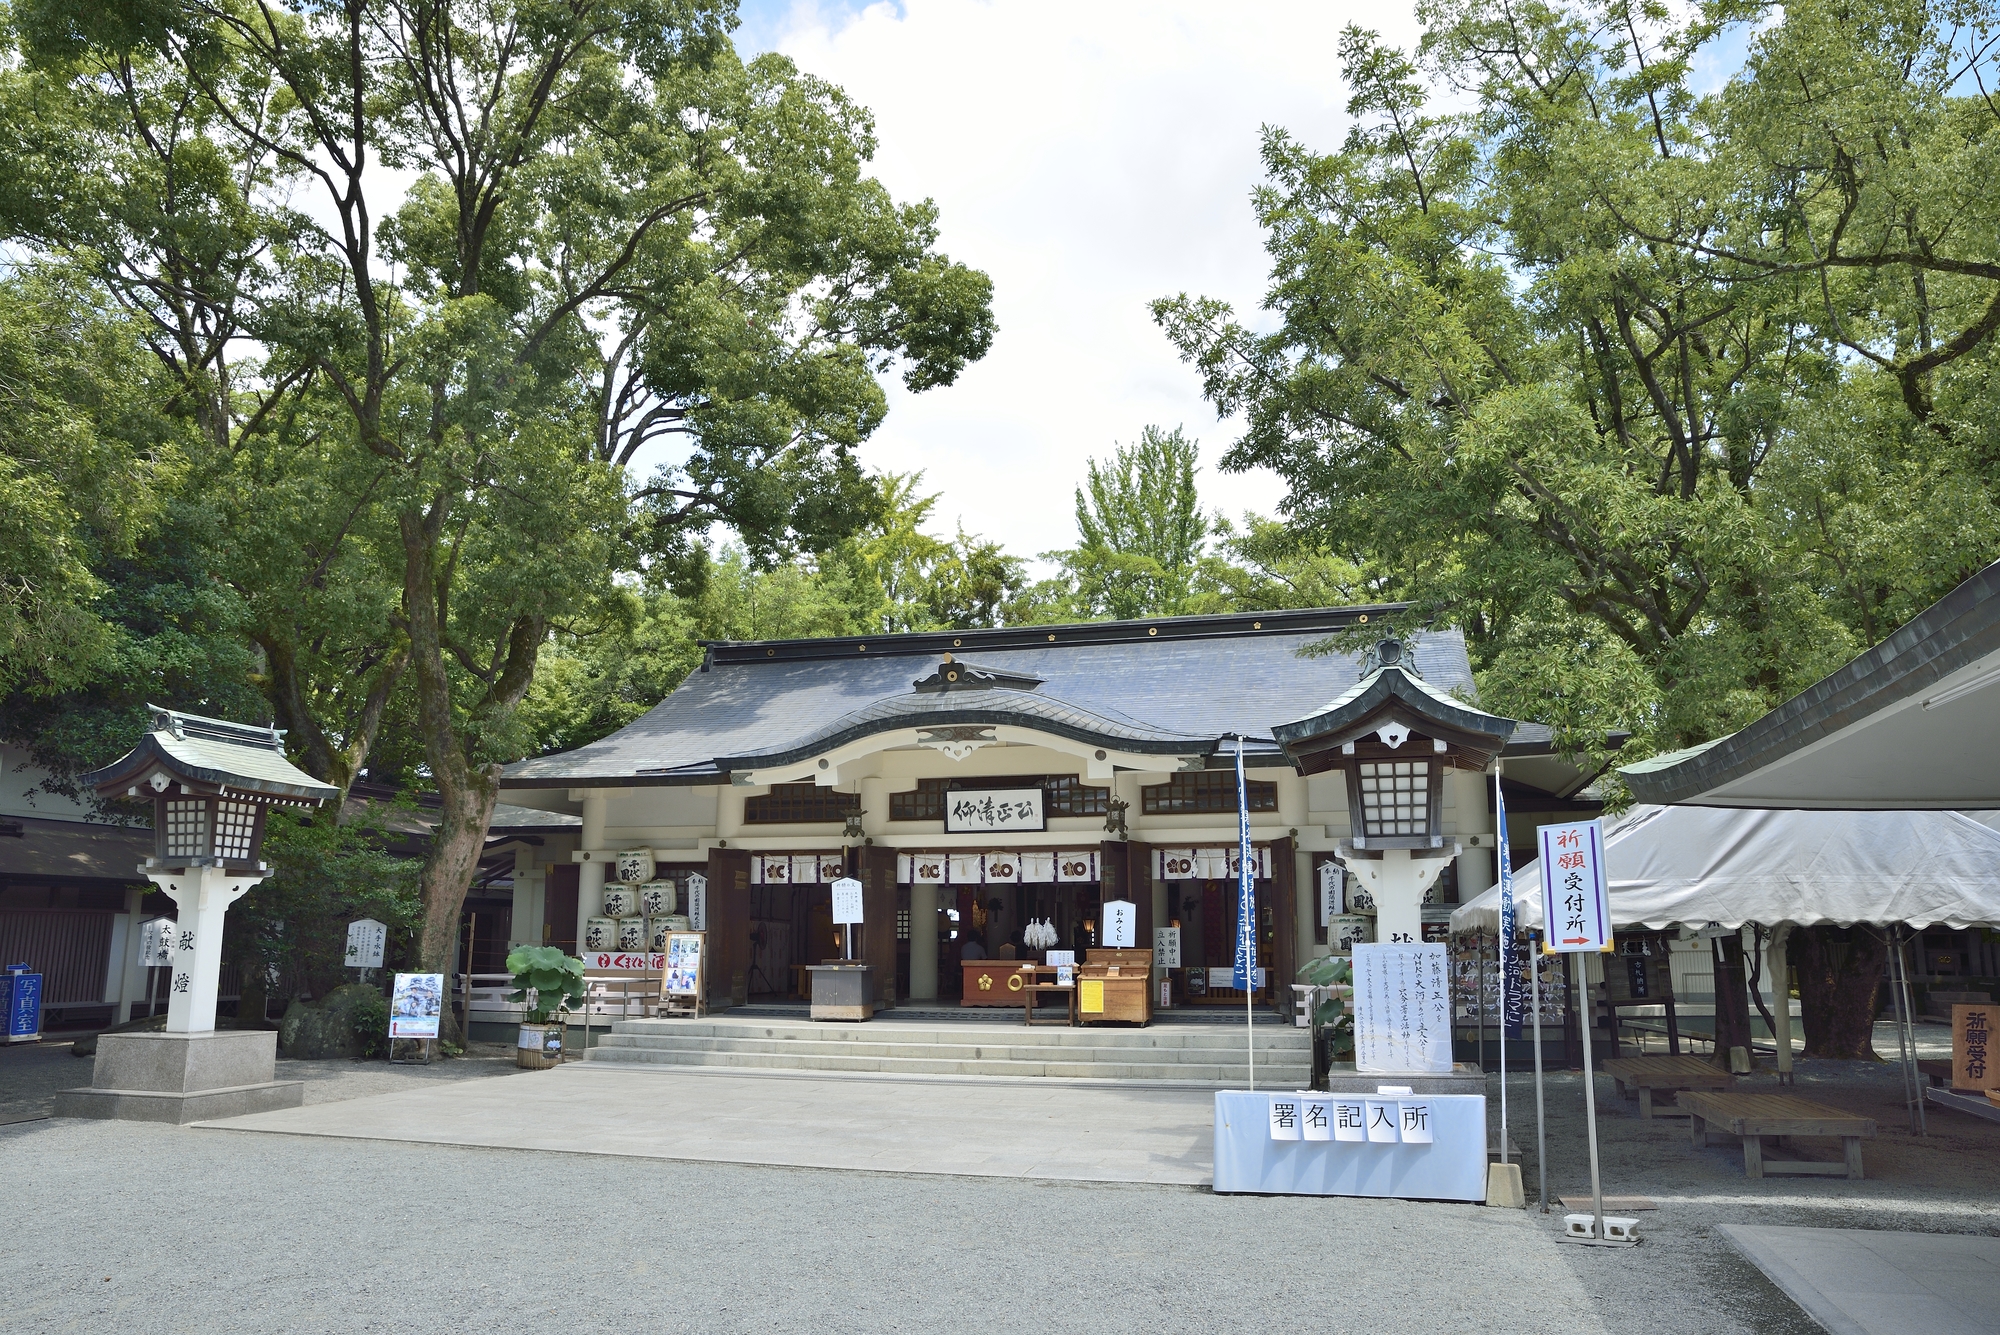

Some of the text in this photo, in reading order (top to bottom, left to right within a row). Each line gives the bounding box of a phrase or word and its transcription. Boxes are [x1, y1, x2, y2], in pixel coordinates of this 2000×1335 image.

[1556, 829, 1586, 934] 祈願受付所
[156, 924, 172, 960] 太鼓橋
[372, 926, 383, 958] 大手水鉢
[1115, 909, 1124, 942] おみくじ
[173, 930, 195, 993] 献燈
[1157, 930, 1166, 965] 立入禁止
[1168, 930, 1177, 965] 祈願中は
[16, 978, 37, 1032] 写真室
[1965, 1011, 1988, 1079] 祈願受付
[1273, 1103, 1429, 1131] 署名記入所
